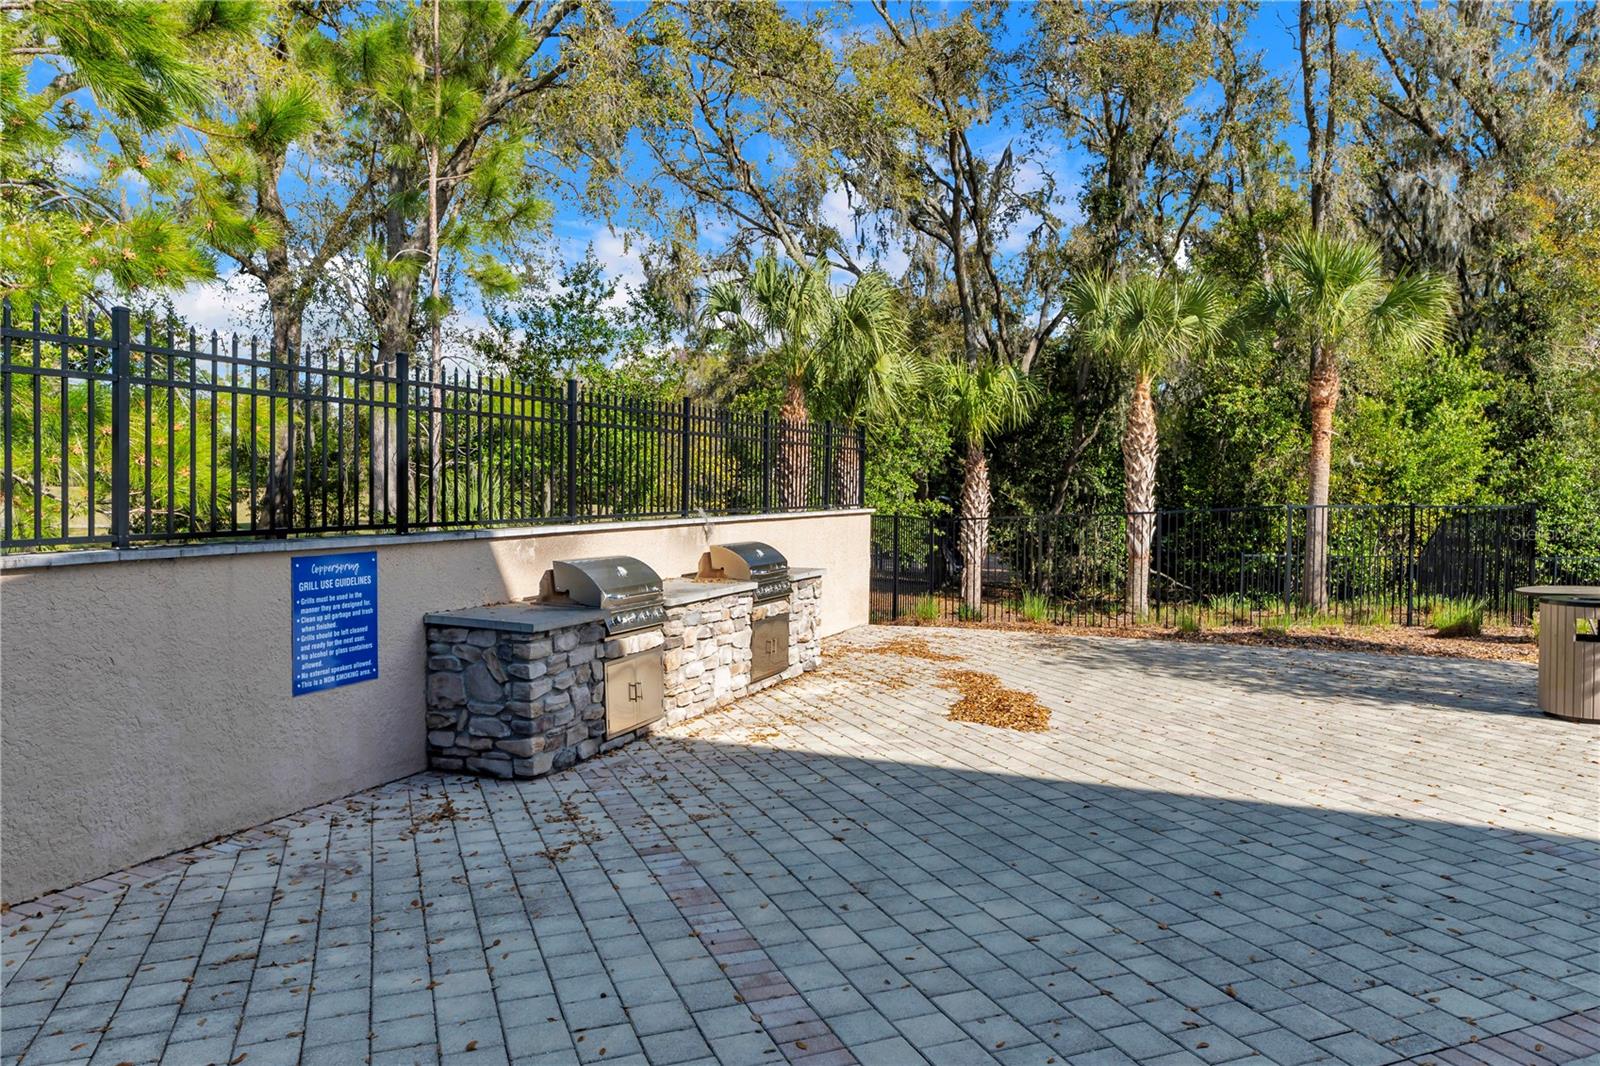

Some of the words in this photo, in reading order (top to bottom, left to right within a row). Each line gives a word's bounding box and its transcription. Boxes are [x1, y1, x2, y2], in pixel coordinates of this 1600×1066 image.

[311, 563, 359, 575] Copperspring
[299, 581, 319, 592] GRILL
[321, 579, 333, 589] USE
[335, 576, 371, 587] GUIDELINES
[332, 611, 351, 620] garbage
[316, 631, 332, 640] should
[350, 626, 368, 634] cleaned
[310, 650, 328, 659] alcohol
[335, 648, 348, 656] glass
[310, 668, 330, 677] external
[331, 665, 352, 674] speakers
[336, 671, 359, 681] SMOKING
